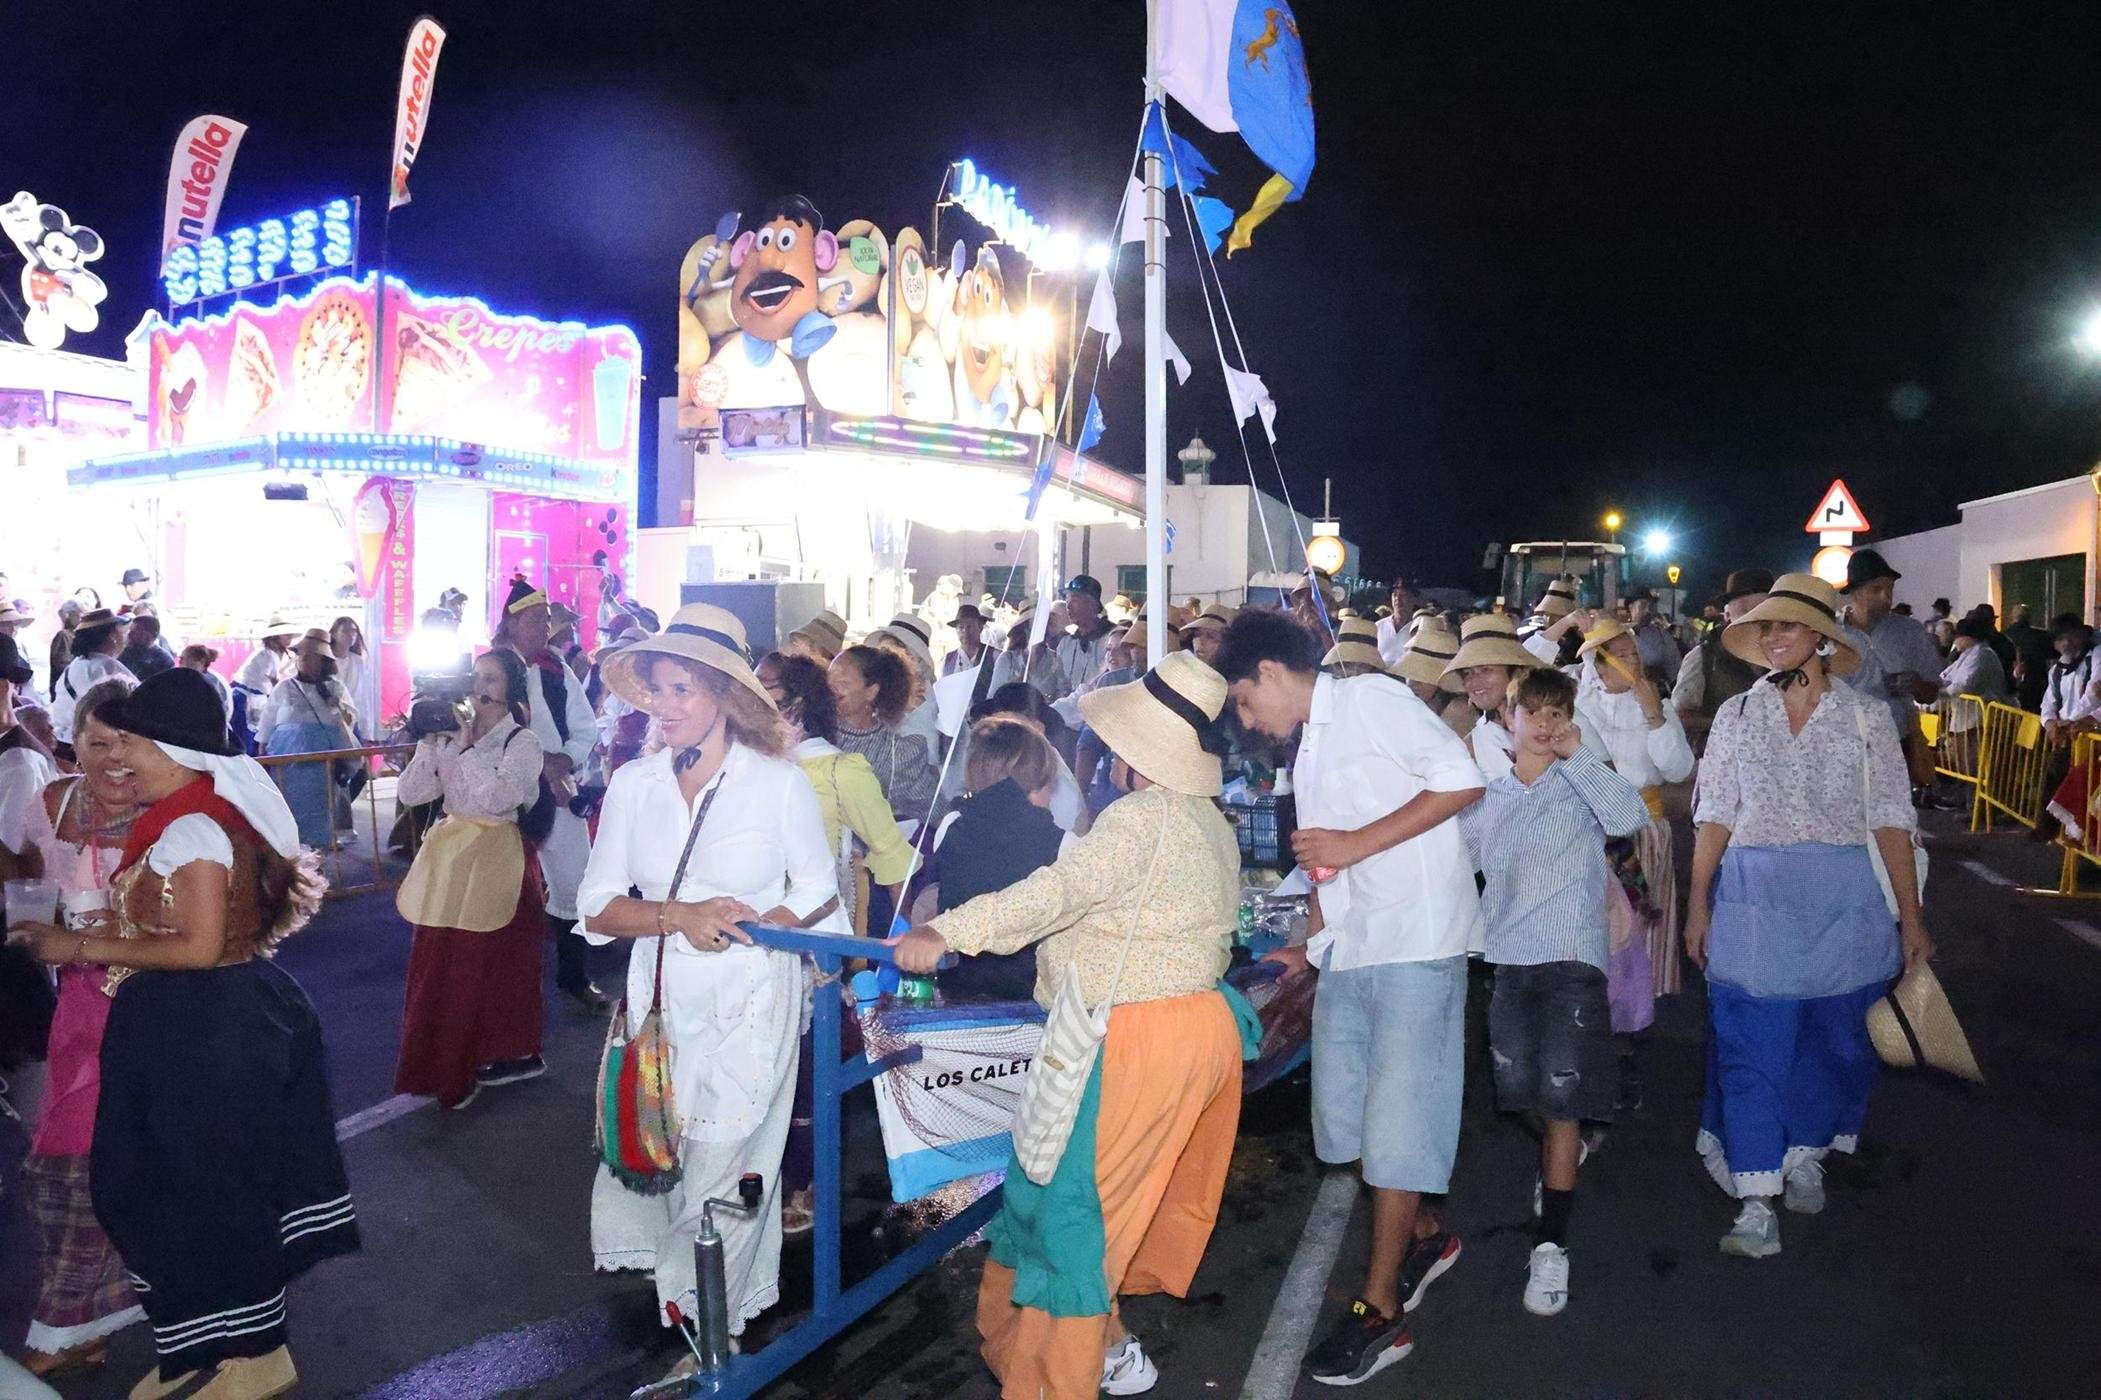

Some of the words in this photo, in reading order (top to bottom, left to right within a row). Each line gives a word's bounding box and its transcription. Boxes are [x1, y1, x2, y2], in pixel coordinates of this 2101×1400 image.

[402, 29, 437, 170] nutella
[177, 121, 233, 243] nutella
[165, 199, 352, 305] CREPES
[904, 277, 924, 294] VEGAN
[440, 308, 583, 363] Crepes
[494, 461, 533, 474] OREO
[923, 1070, 964, 1092] LOS
[970, 1058, 1032, 1083] CALET
